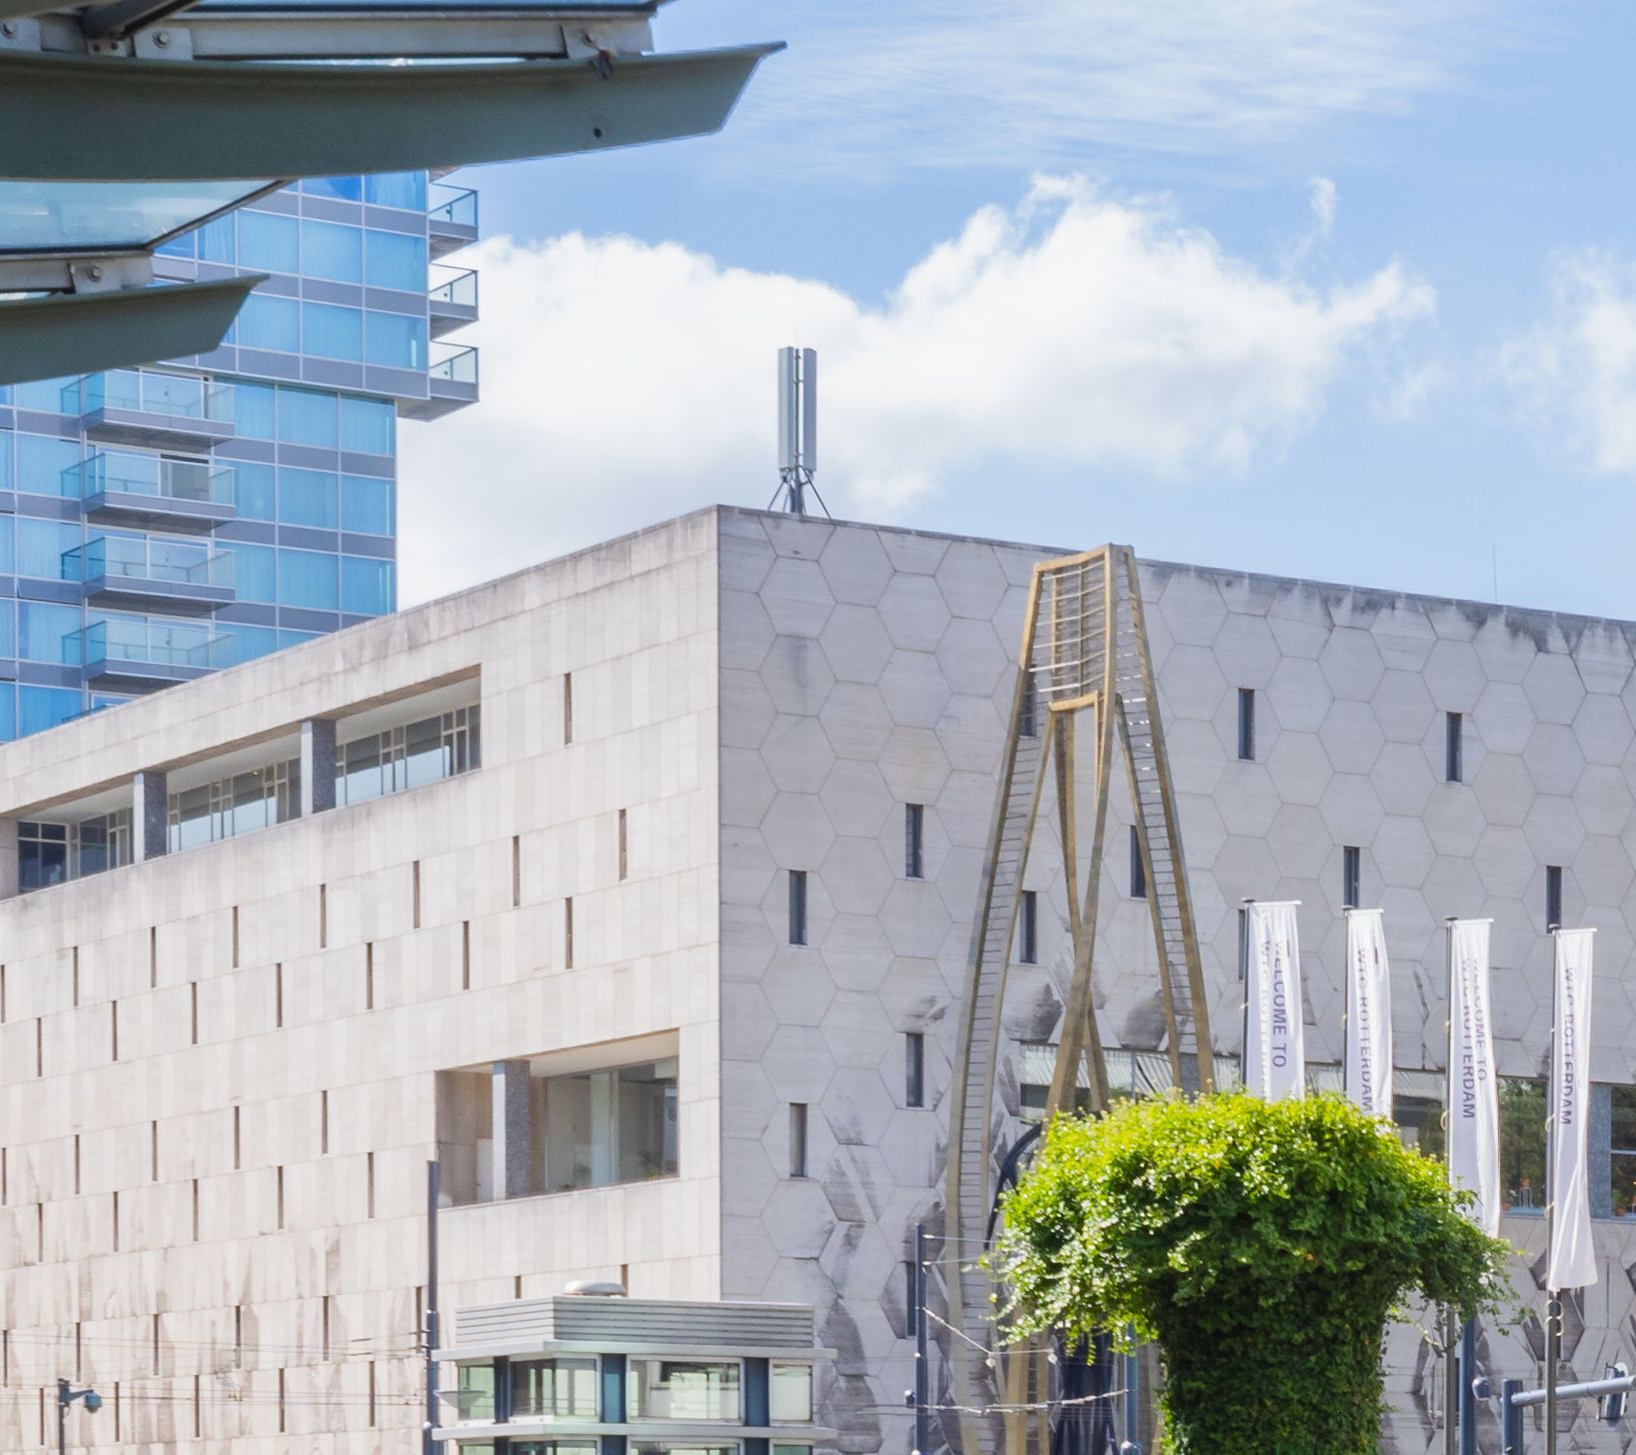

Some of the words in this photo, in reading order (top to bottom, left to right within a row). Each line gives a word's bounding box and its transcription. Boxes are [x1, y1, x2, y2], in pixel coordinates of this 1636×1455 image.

[1272, 1043, 1287, 1068] TO
[1359, 996, 1373, 1111] ROTTERDAM
[1462, 1003, 1476, 1118] ROTTERDAM
[1476, 1056, 1488, 1082] TO
[1561, 1013, 1574, 1125] ROTTERDAM
